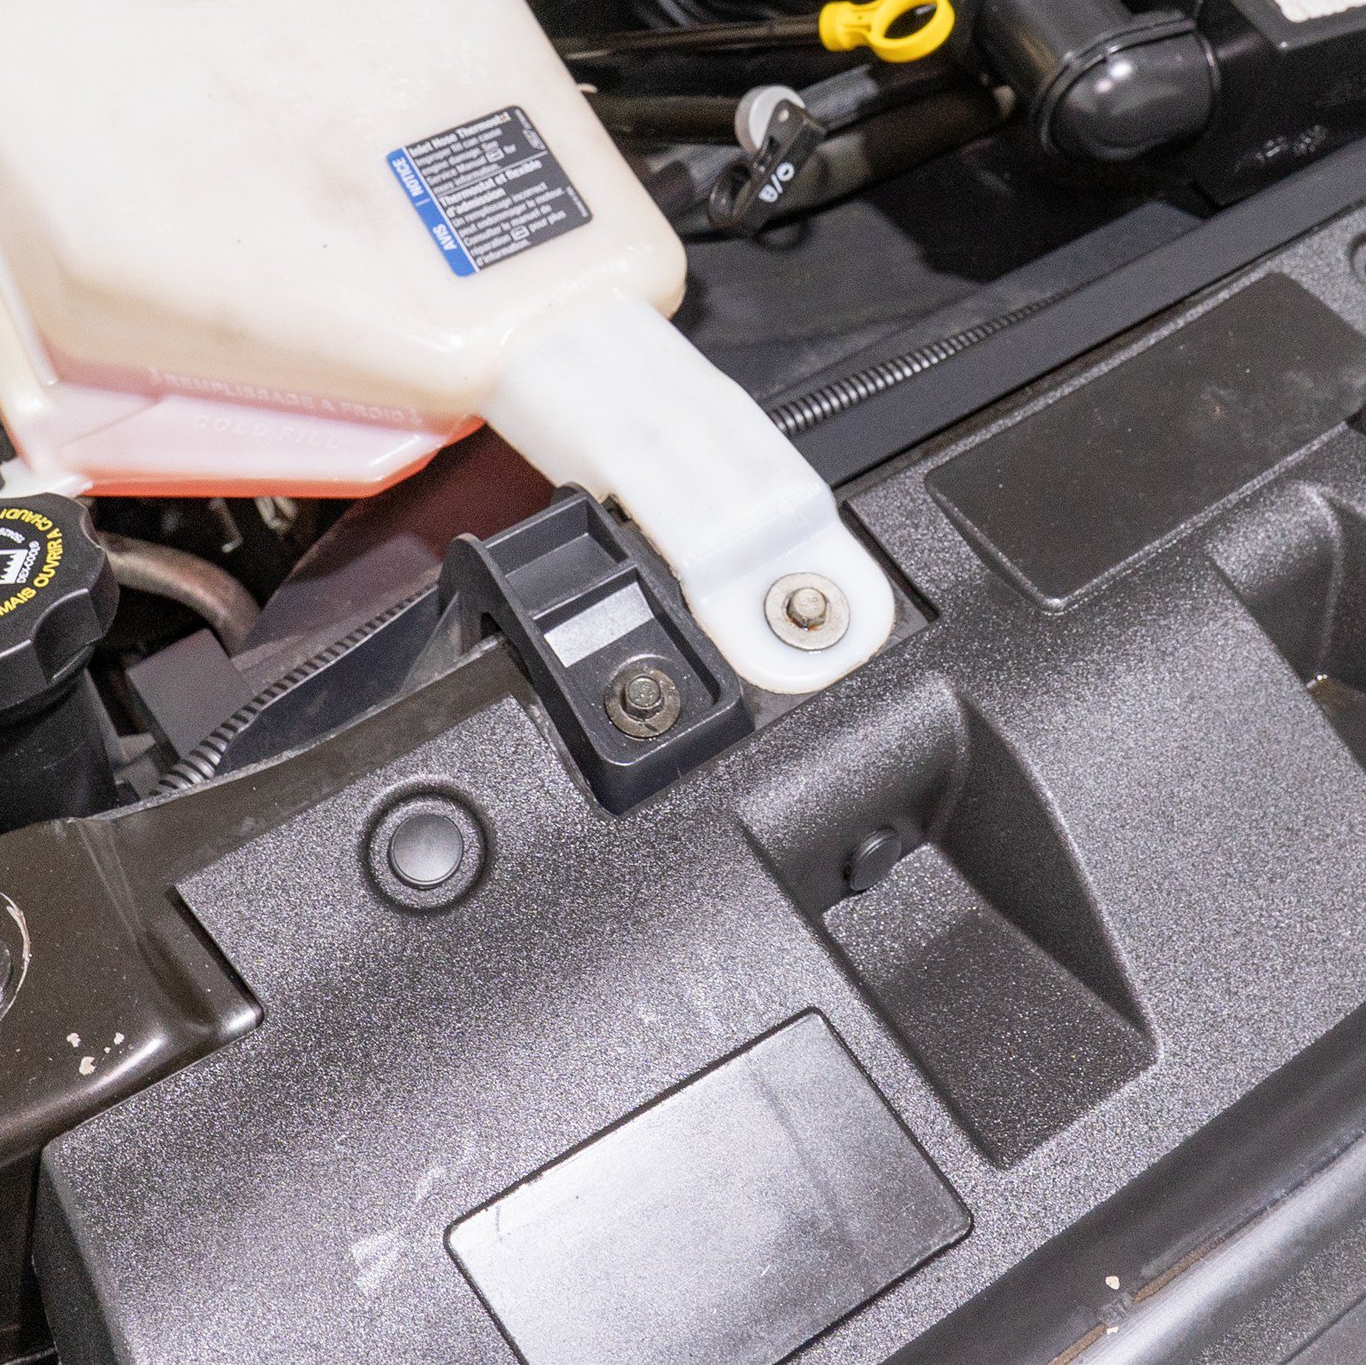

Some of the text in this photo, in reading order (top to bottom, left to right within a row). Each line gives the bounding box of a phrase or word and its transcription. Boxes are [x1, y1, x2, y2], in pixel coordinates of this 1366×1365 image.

[455, 110, 513, 140] Thermostat
[392, 157, 424, 197] NOTICE
[438, 158, 544, 208] Thermostat et flexible
[432, 223, 458, 252] AVIS
[339, 400, 405, 422] FROID
[193, 413, 339, 450] COLD FILL
[33, 536, 63, 588] OUVRIR
